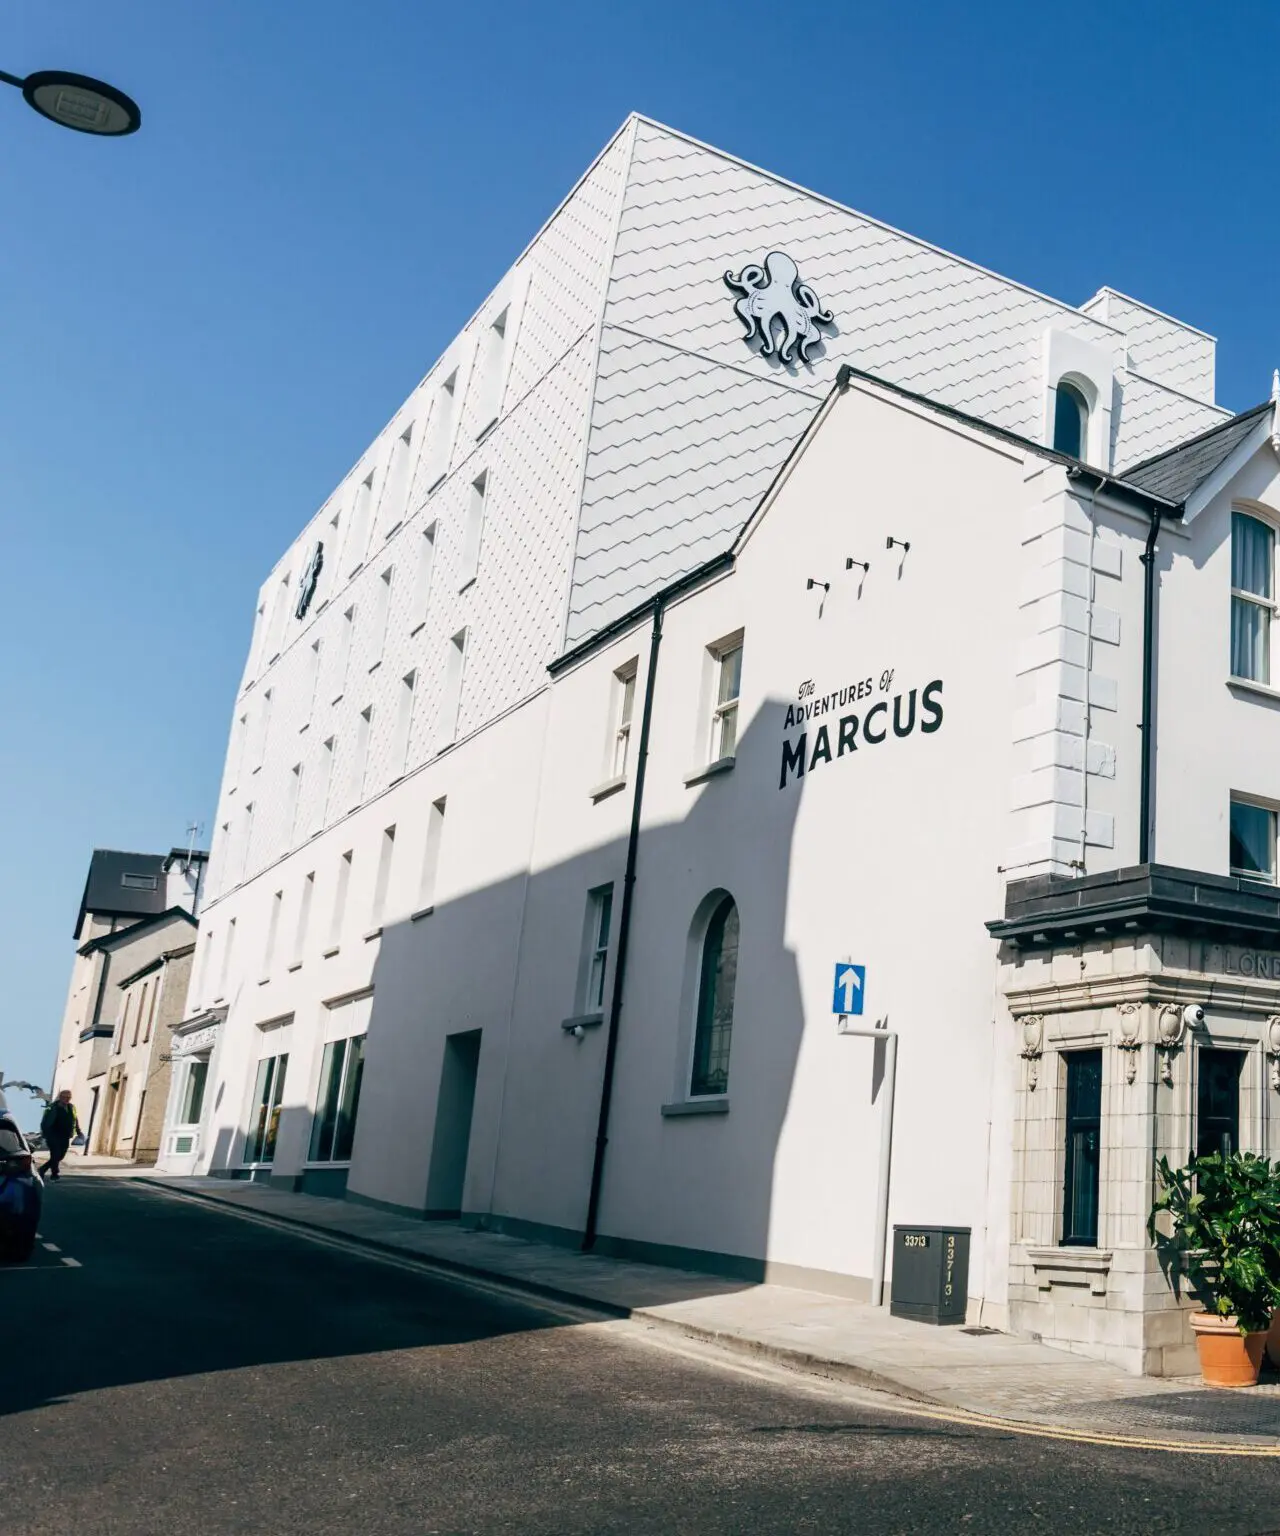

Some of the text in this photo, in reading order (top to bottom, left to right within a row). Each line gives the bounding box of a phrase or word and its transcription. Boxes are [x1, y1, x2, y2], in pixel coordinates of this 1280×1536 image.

[784, 669, 895, 730] ADVENTURES Of
[798, 678, 816, 700] The
[779, 680, 944, 790] MARCUS
[904, 1235, 926, 1248] 33713
